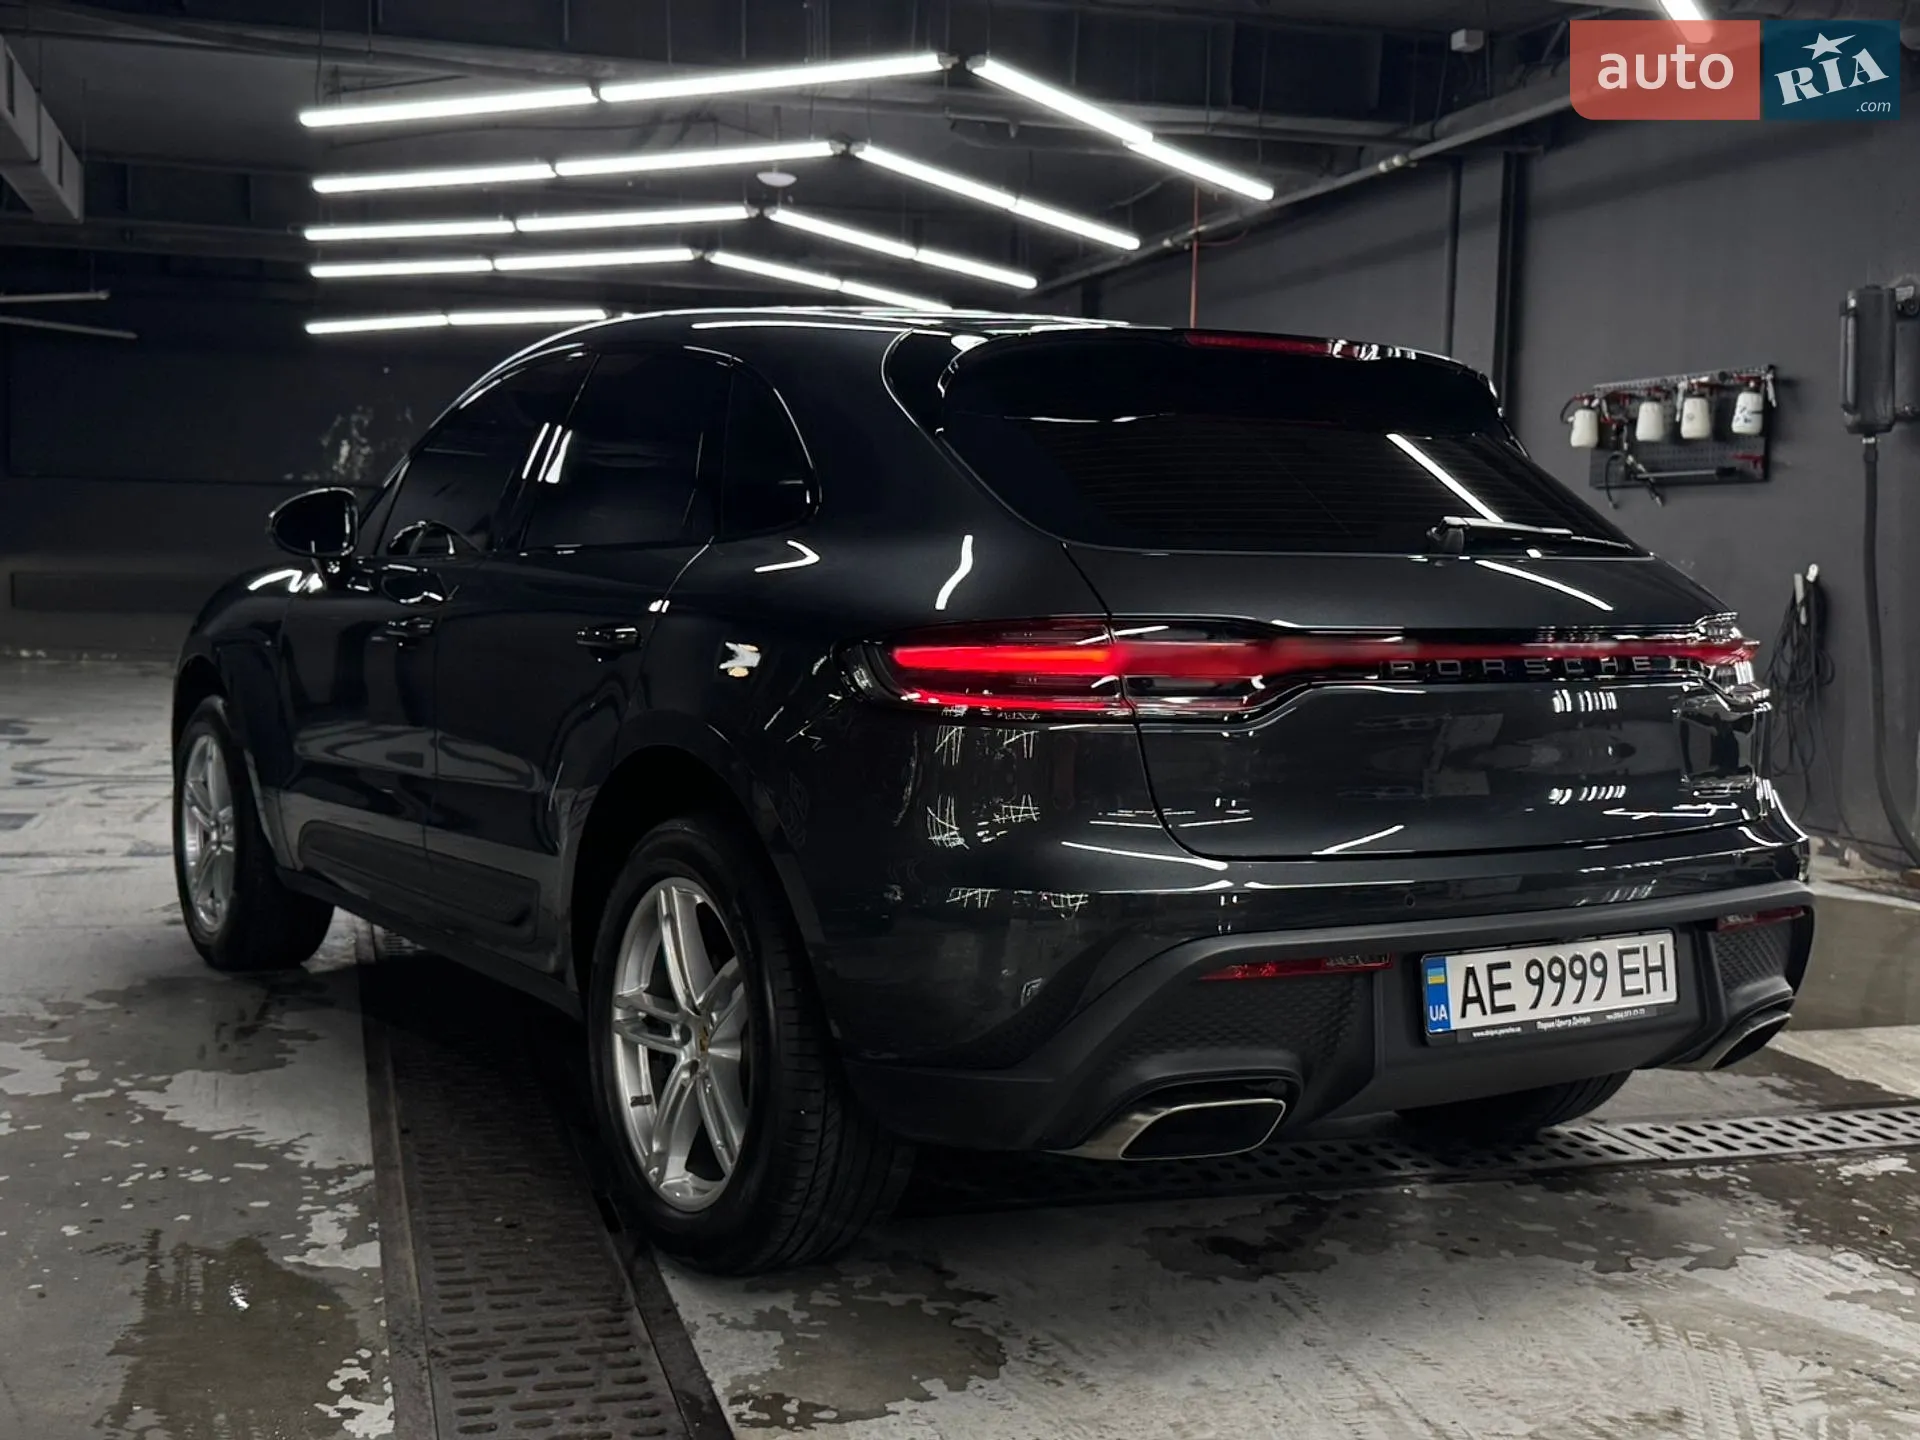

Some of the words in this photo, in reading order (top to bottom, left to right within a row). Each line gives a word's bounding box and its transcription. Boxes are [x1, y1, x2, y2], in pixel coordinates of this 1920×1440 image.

[1389, 656, 1651, 676] PORSCHE
[1460, 961, 1517, 1019] AE
[1524, 951, 1608, 1011] 9999
[1617, 943, 1668, 998] EH
[1429, 1004, 1449, 1022] UA
